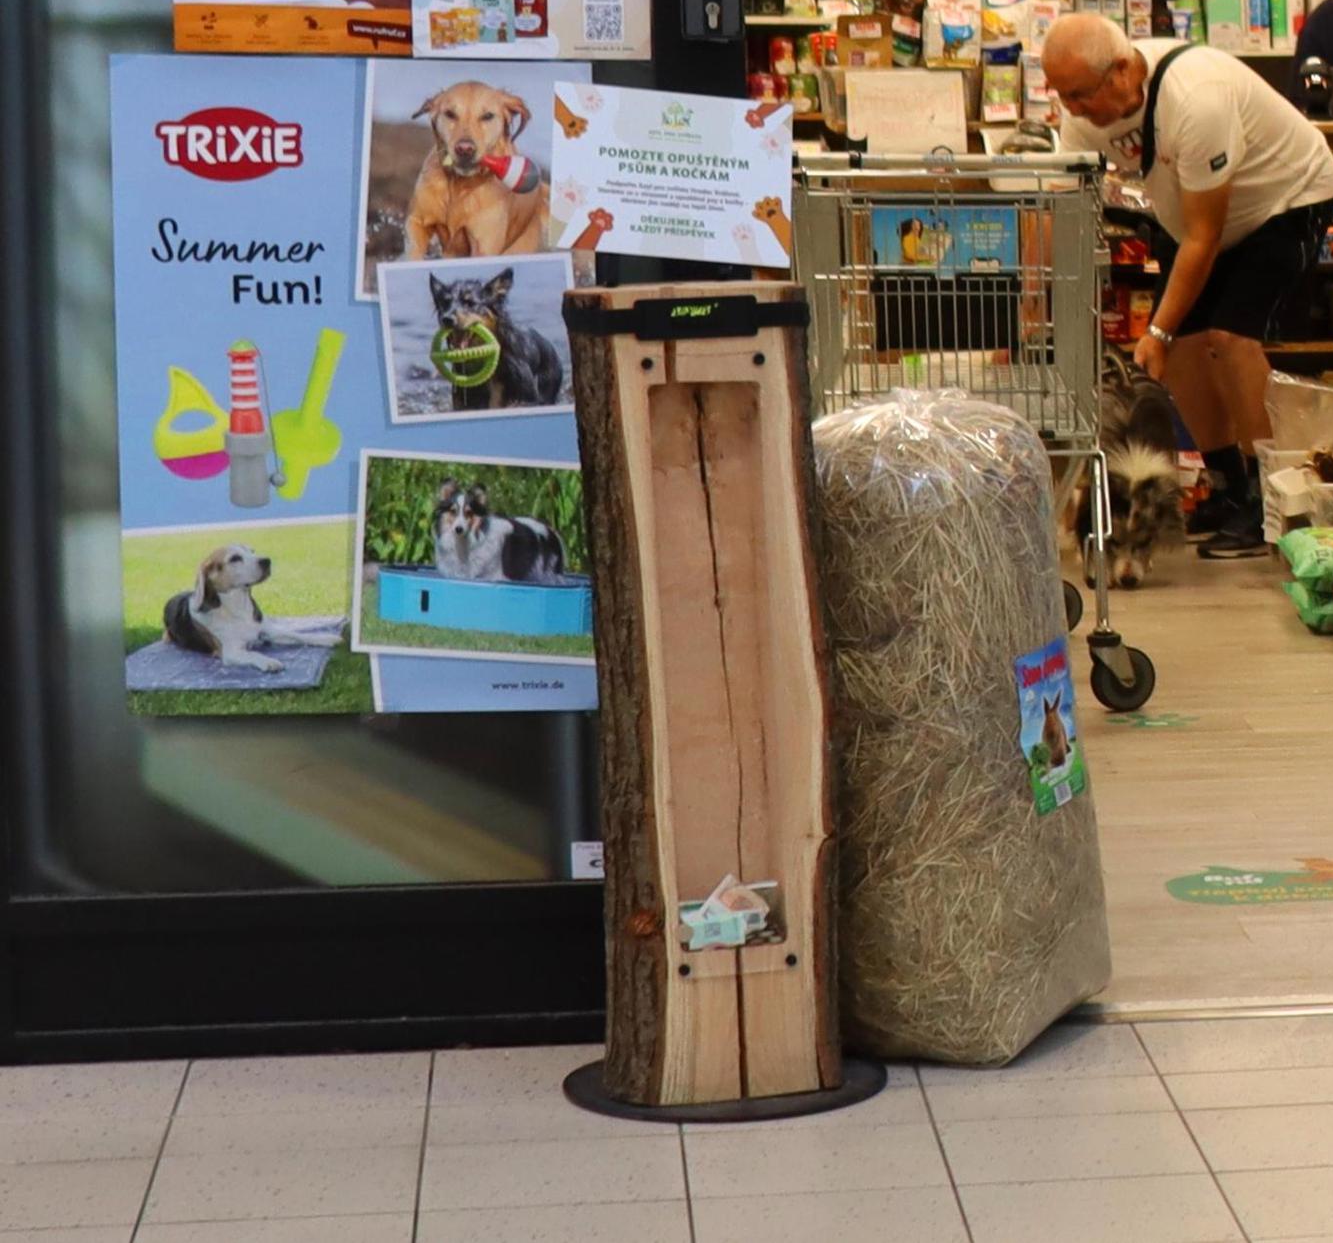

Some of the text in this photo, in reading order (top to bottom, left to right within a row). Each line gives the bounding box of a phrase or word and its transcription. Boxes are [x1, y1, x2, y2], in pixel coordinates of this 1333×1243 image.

[598, 146, 750, 171] POMOZTE OPUŠTĚNÝM
[618, 160, 657, 175] PSŮM
[659, 166, 668, 176] A
[152, 217, 325, 263] Summer
[233, 274, 323, 305] Fun!
